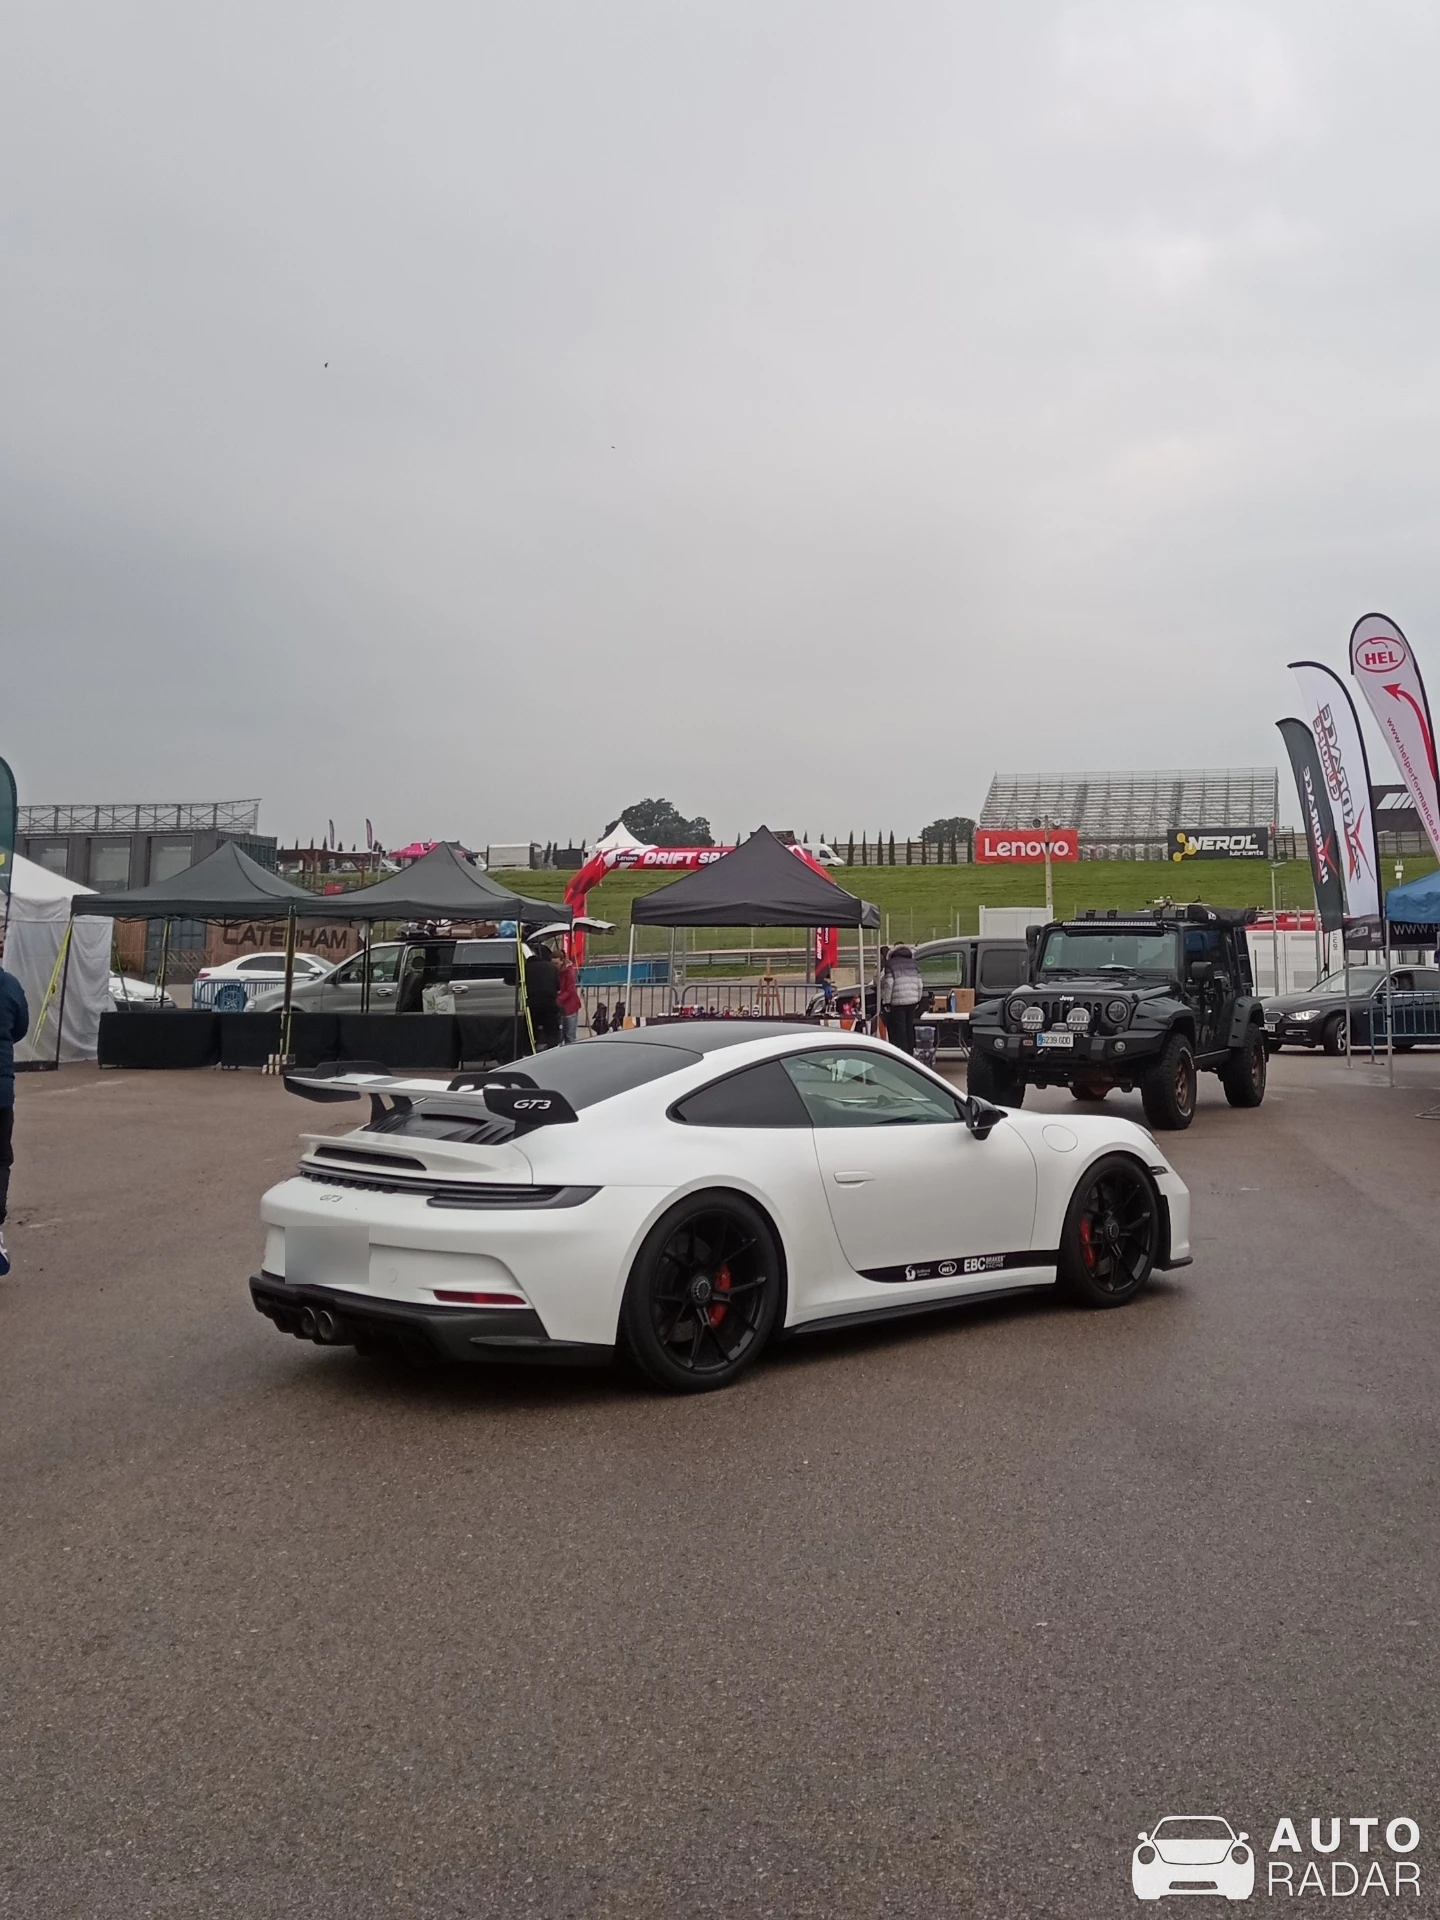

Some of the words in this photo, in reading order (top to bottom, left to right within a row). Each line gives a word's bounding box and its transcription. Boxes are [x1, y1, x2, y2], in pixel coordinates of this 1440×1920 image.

[1364, 651, 1398, 665] HEL
[1387, 717, 1439, 841] www.helperformance.es
[984, 838, 1069, 856] Lenovo
[643, 852, 697, 864] DRIFT
[222, 925, 348, 949] CATEHAM
[513, 1099, 552, 1110] GT3
[320, 1194, 343, 1203] GT3
[964, 1257, 986, 1272] EBC
